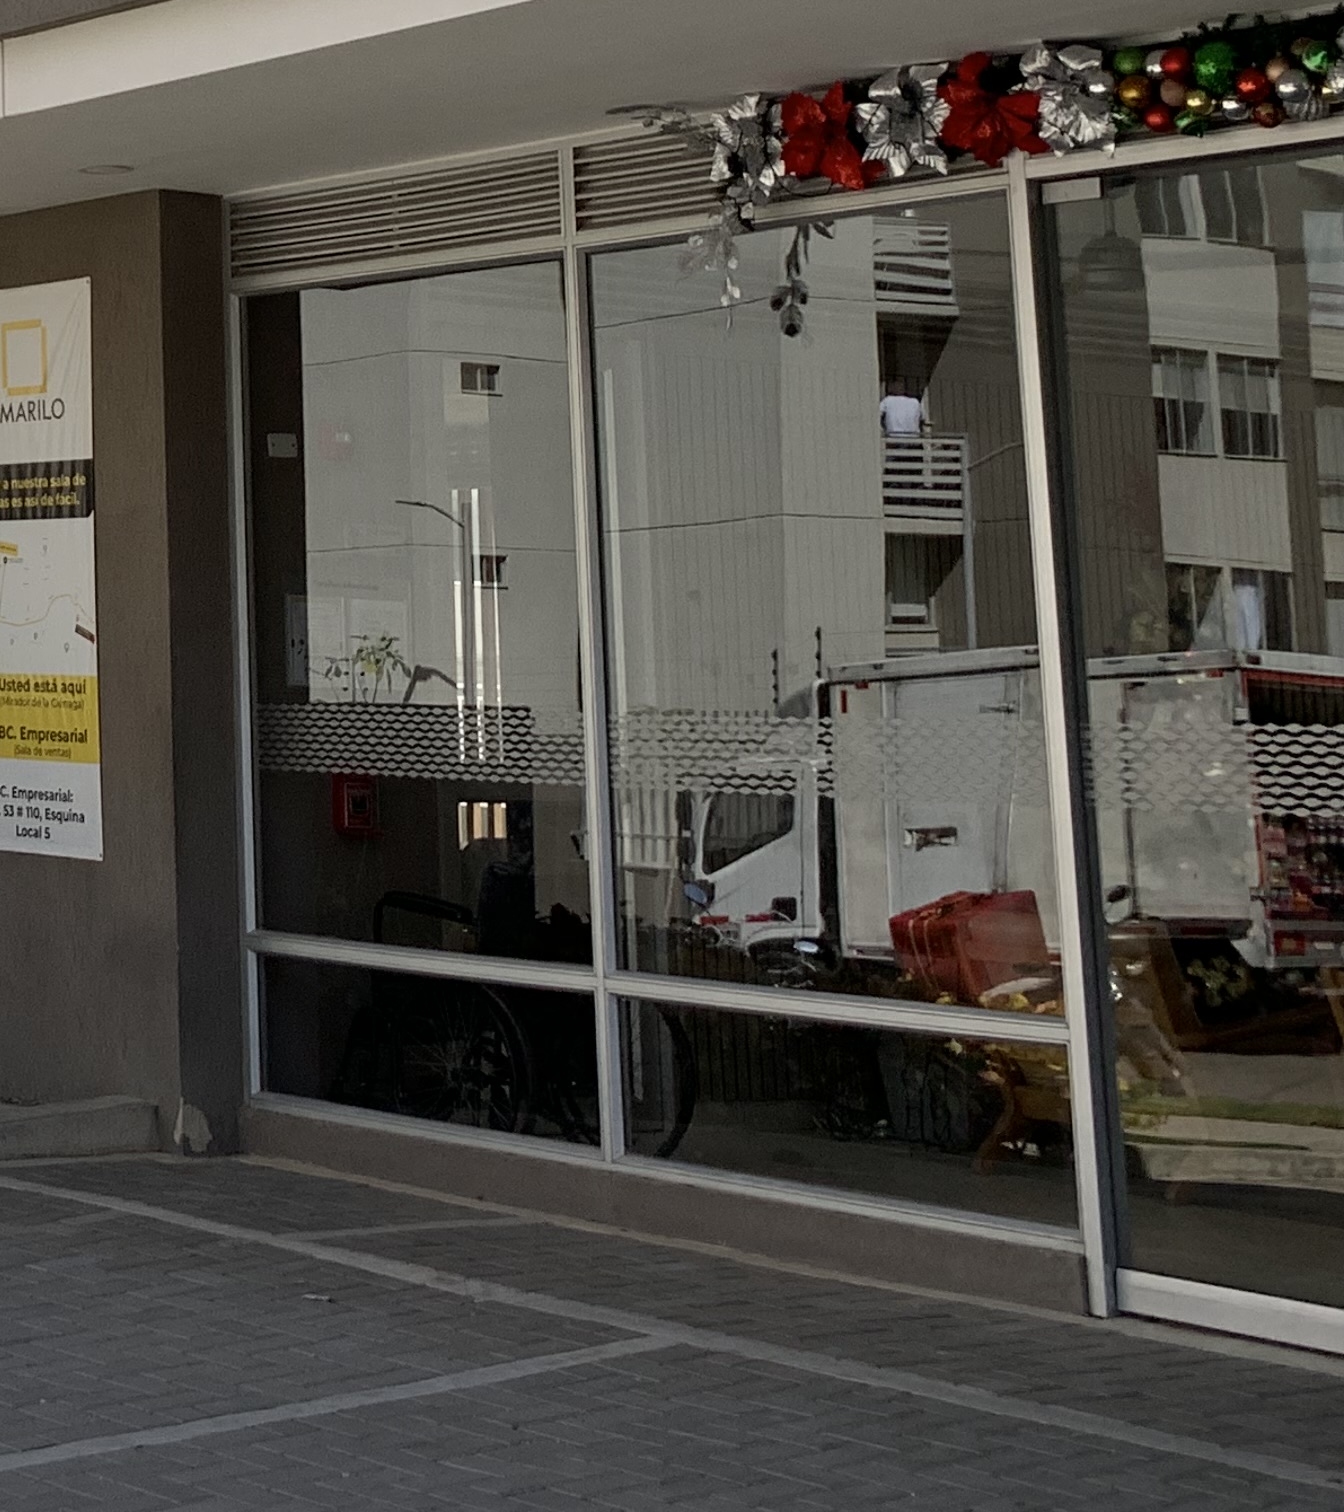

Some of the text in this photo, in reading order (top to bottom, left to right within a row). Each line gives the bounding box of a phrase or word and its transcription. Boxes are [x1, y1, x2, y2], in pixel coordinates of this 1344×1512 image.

[2, 480, 9, 491] a
[11, 476, 49, 490] nuestra
[50, 473, 71, 488] sala
[72, 472, 86, 487] de
[11, 496, 24, 508] es
[40, 493, 53, 507] de
[33, 677, 58, 694] está
[60, 678, 86, 697] aquí
[20, 726, 88, 745] Empresarial
[33, 746, 43, 757] de
[11, 786, 74, 803] Empresarial:
[3, 804, 15, 817] 53
[44, 807, 85, 825] Esquina
[15, 825, 51, 840] Local 5
